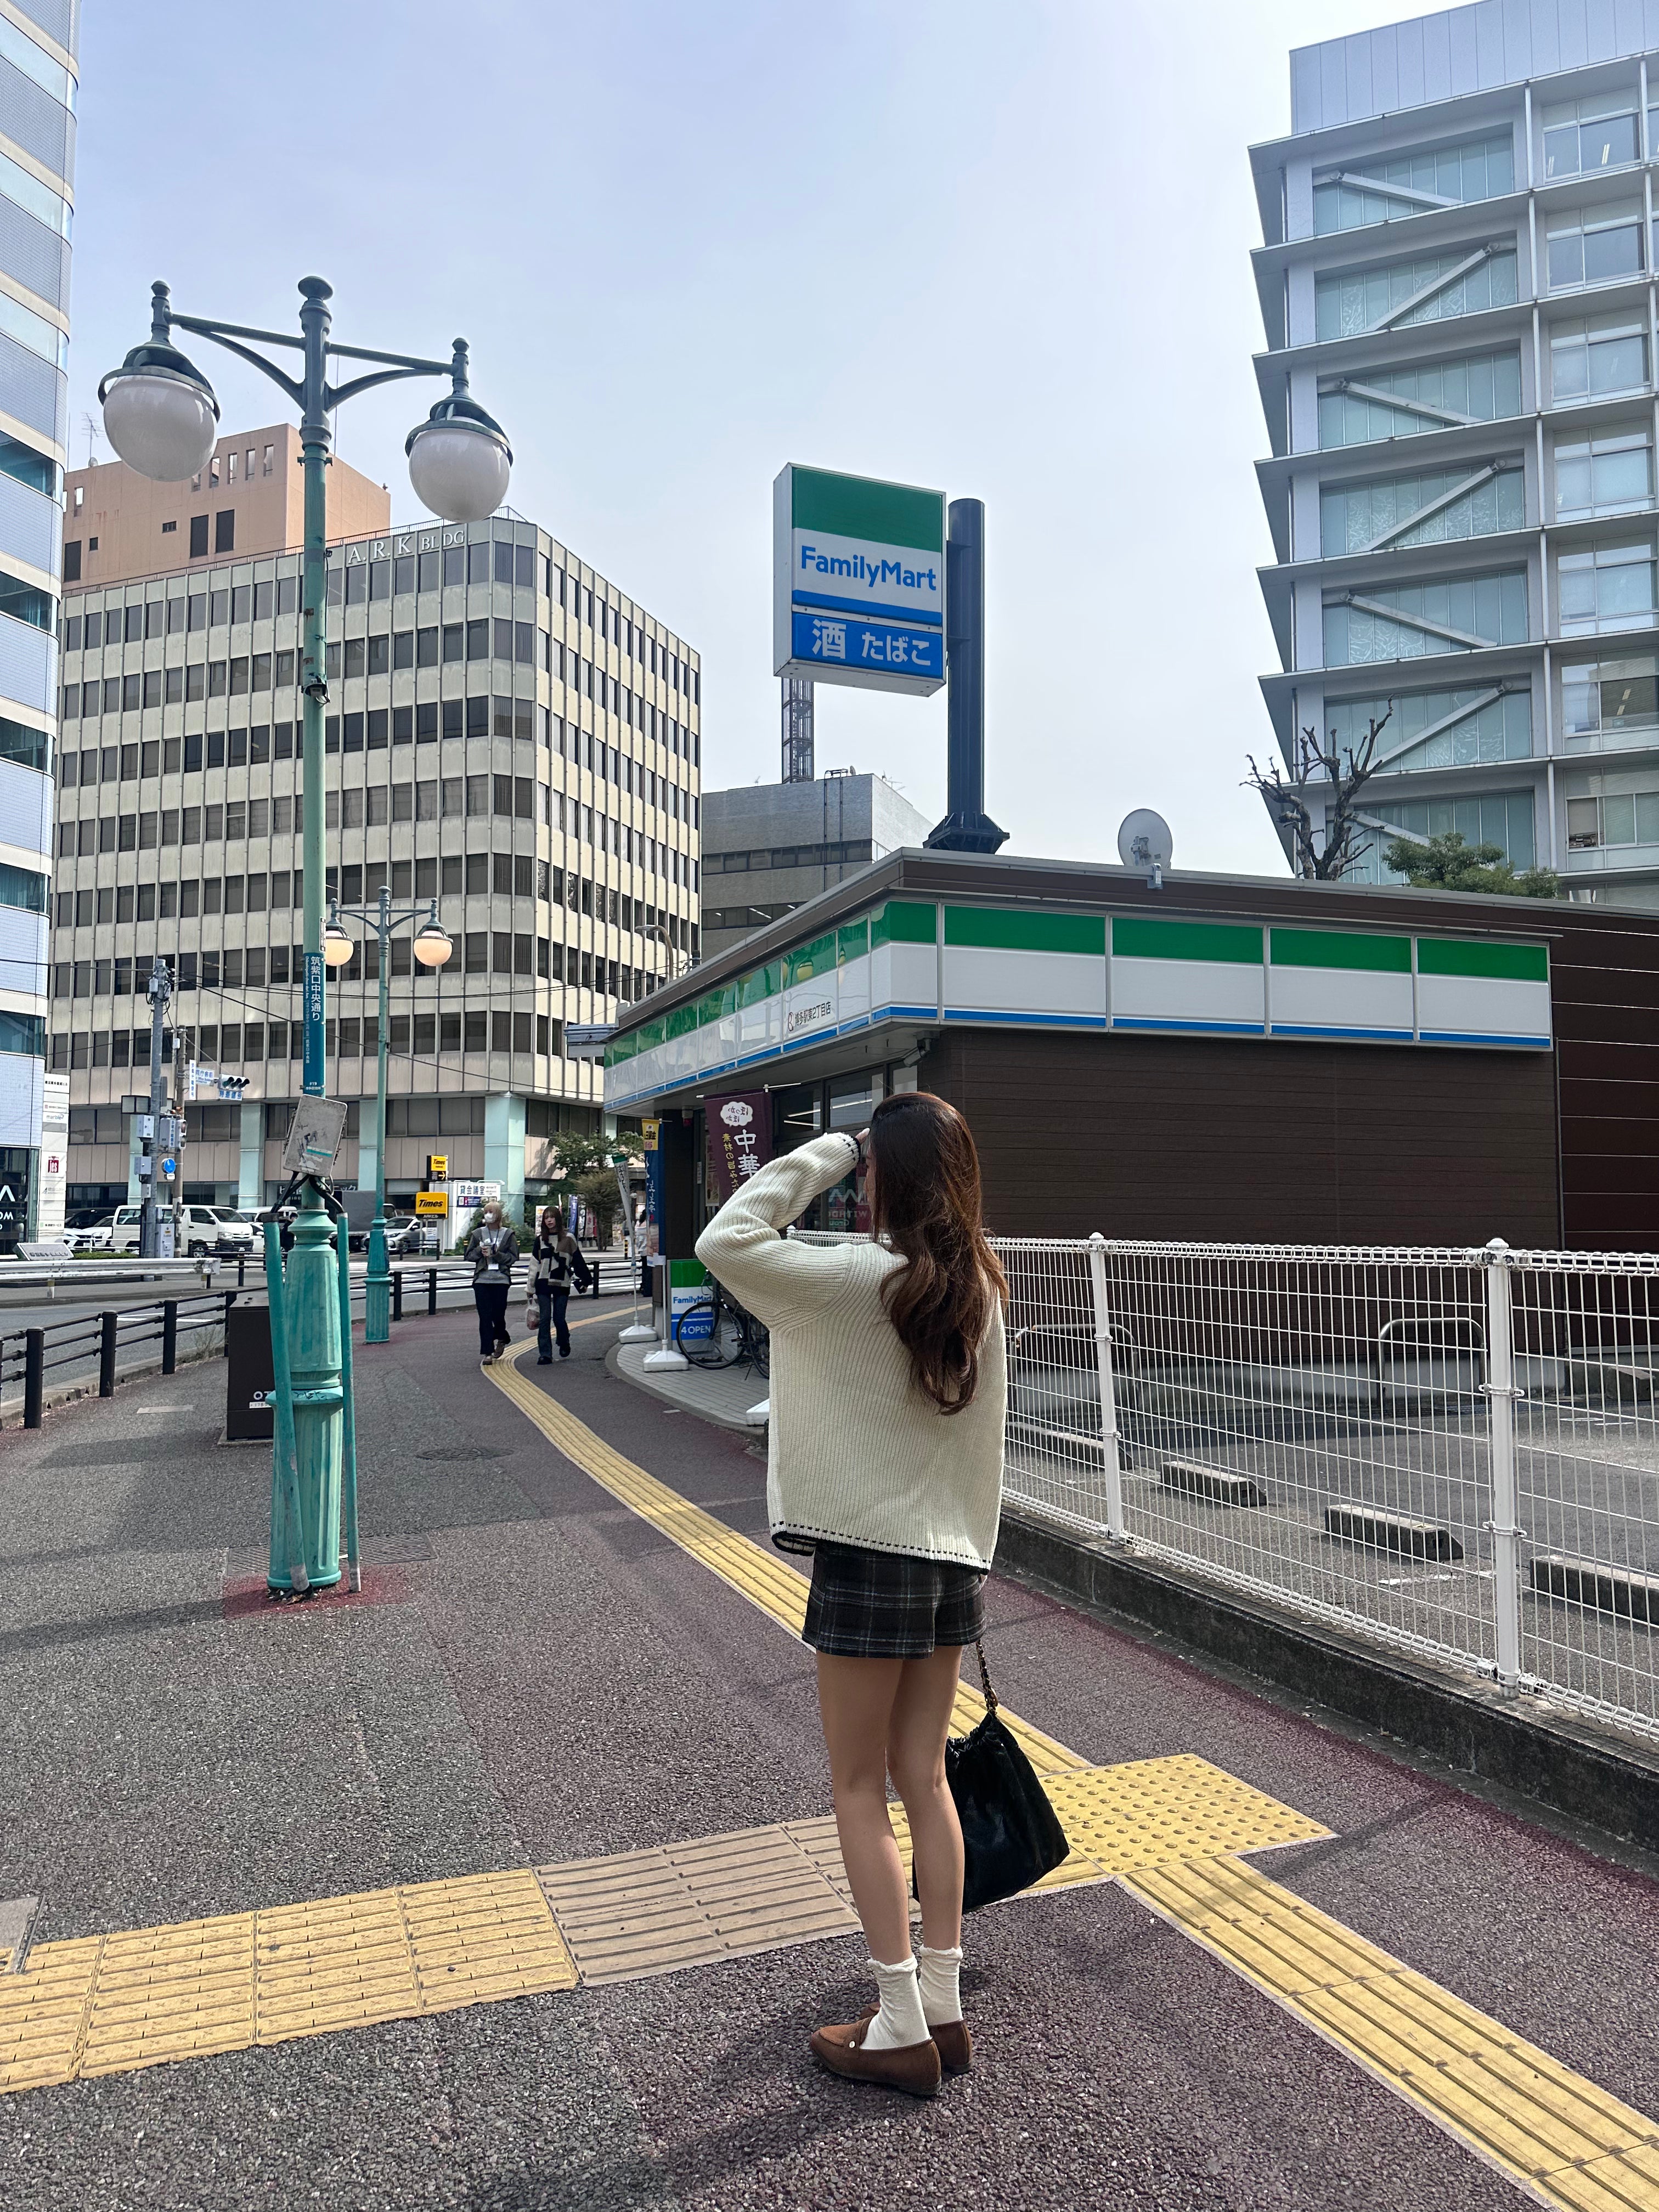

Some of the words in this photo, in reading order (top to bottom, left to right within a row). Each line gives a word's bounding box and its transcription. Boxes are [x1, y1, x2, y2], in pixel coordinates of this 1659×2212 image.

[801, 545, 937, 591] FamilyMart
[812, 618, 847, 659] 酒
[861, 631, 932, 667] たばこ
[311, 956, 321, 1021] 筑紫口中央通り
[794, 1001, 831, 1026] 博多駅東2丁目店
[419, 1199, 443, 1207] Times
[673, 1295, 712, 1304] FamilyMart
[687, 1325, 711, 1335] OPEN
